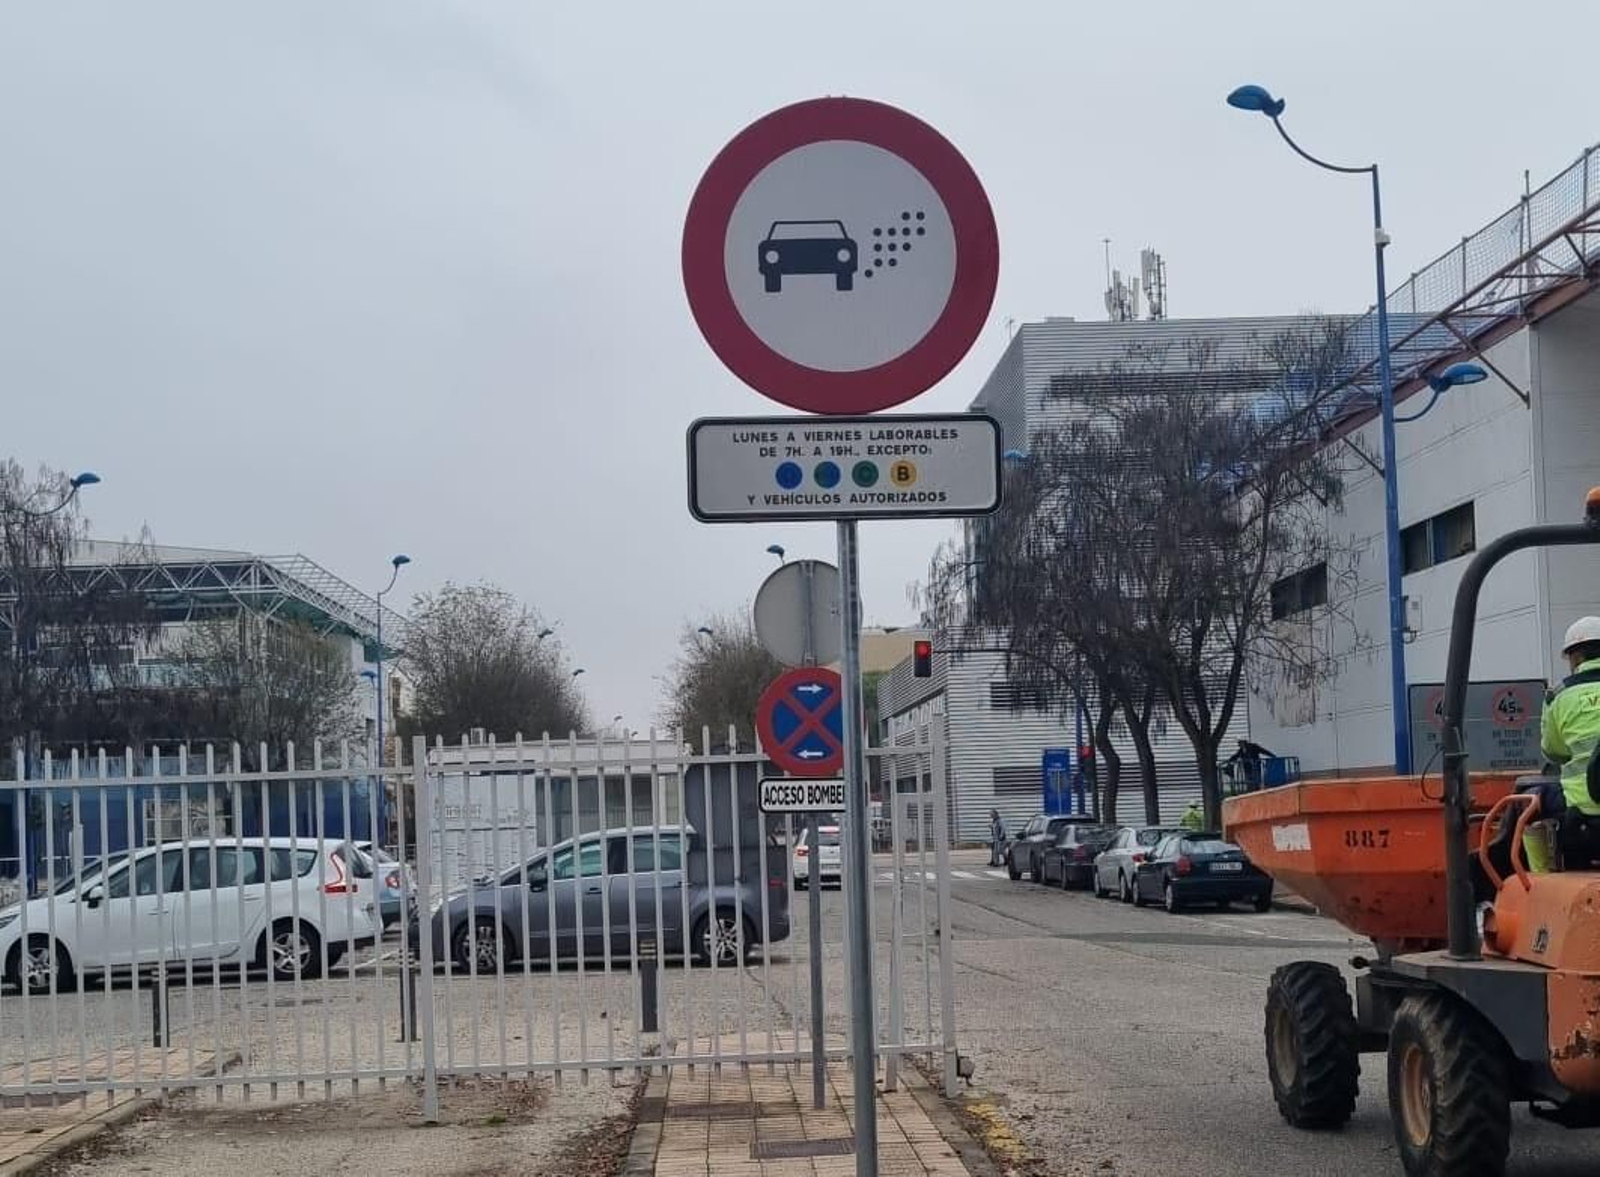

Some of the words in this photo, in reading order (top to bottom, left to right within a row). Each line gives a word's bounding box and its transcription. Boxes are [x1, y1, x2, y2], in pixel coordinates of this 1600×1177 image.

[732, 432, 778, 443] LUNES
[787, 431, 795, 441] A
[804, 430, 862, 441] VIERNES
[869, 428, 958, 440] LABORABLES
[759, 446, 777, 457] DE
[813, 446, 822, 456] A
[897, 466, 910, 482] B
[747, 494, 755, 505] Y
[764, 492, 841, 505] VEHÍCULOS
[850, 491, 947, 503] AUTORIZADOS
[764, 785, 805, 805] ACCESO
[807, 784, 845, 805] BOMBE
[1345, 829, 1390, 848] 887
